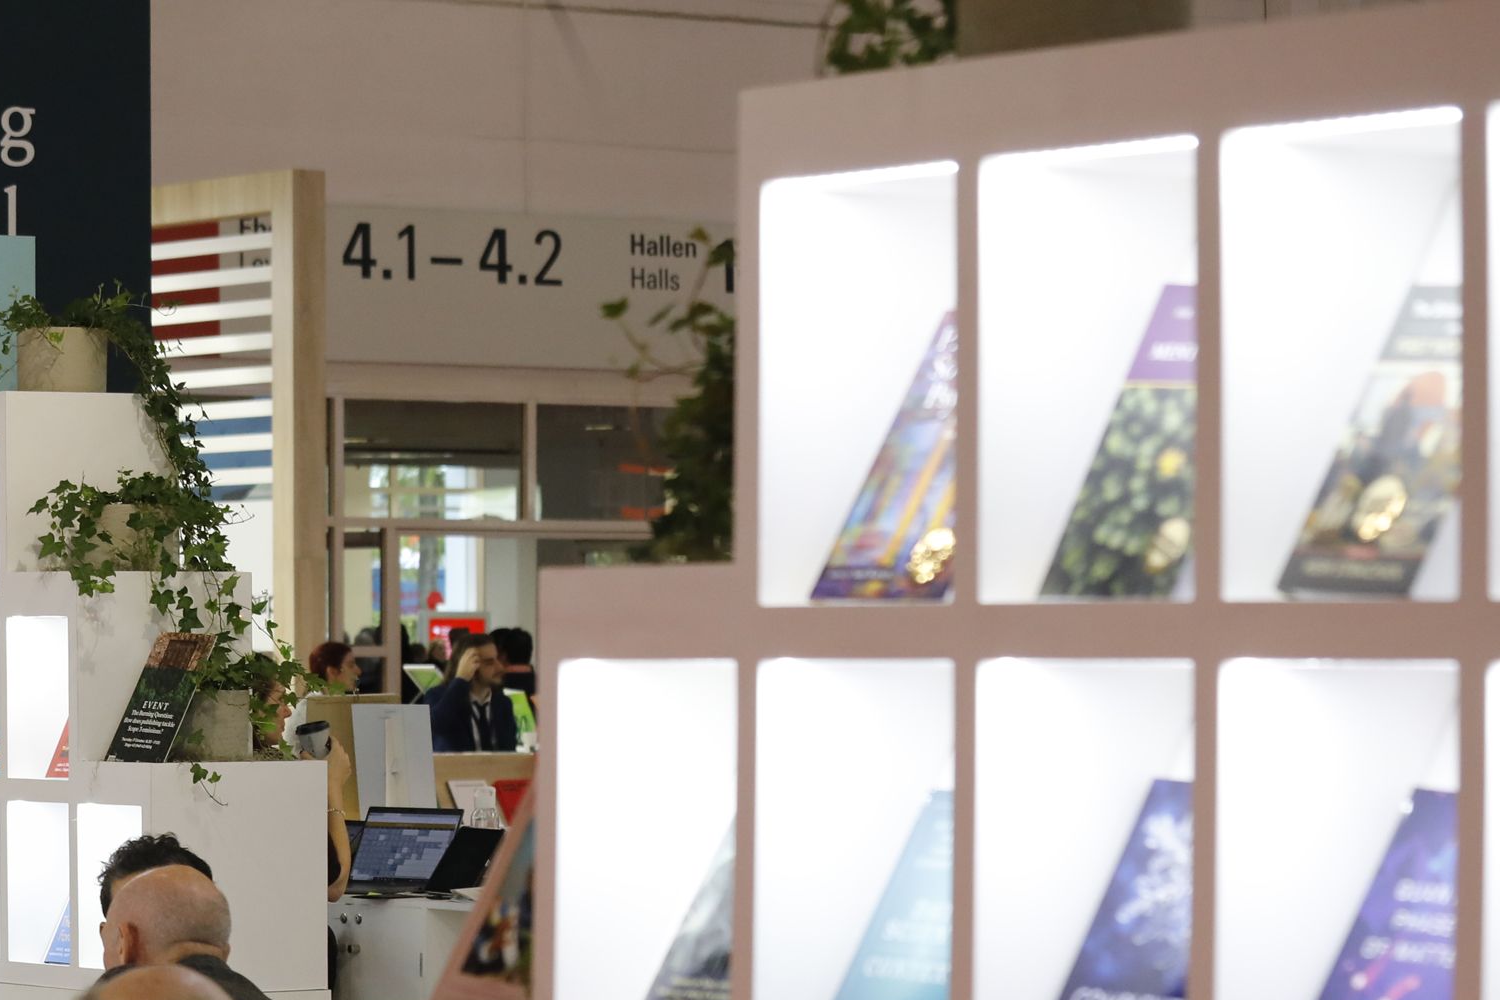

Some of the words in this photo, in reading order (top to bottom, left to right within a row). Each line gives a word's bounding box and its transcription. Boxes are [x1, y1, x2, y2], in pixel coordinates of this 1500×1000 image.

[630, 233, 697, 260] Hallen
[631, 267, 681, 291] Halls
[142, 700, 169, 711] EVENT
